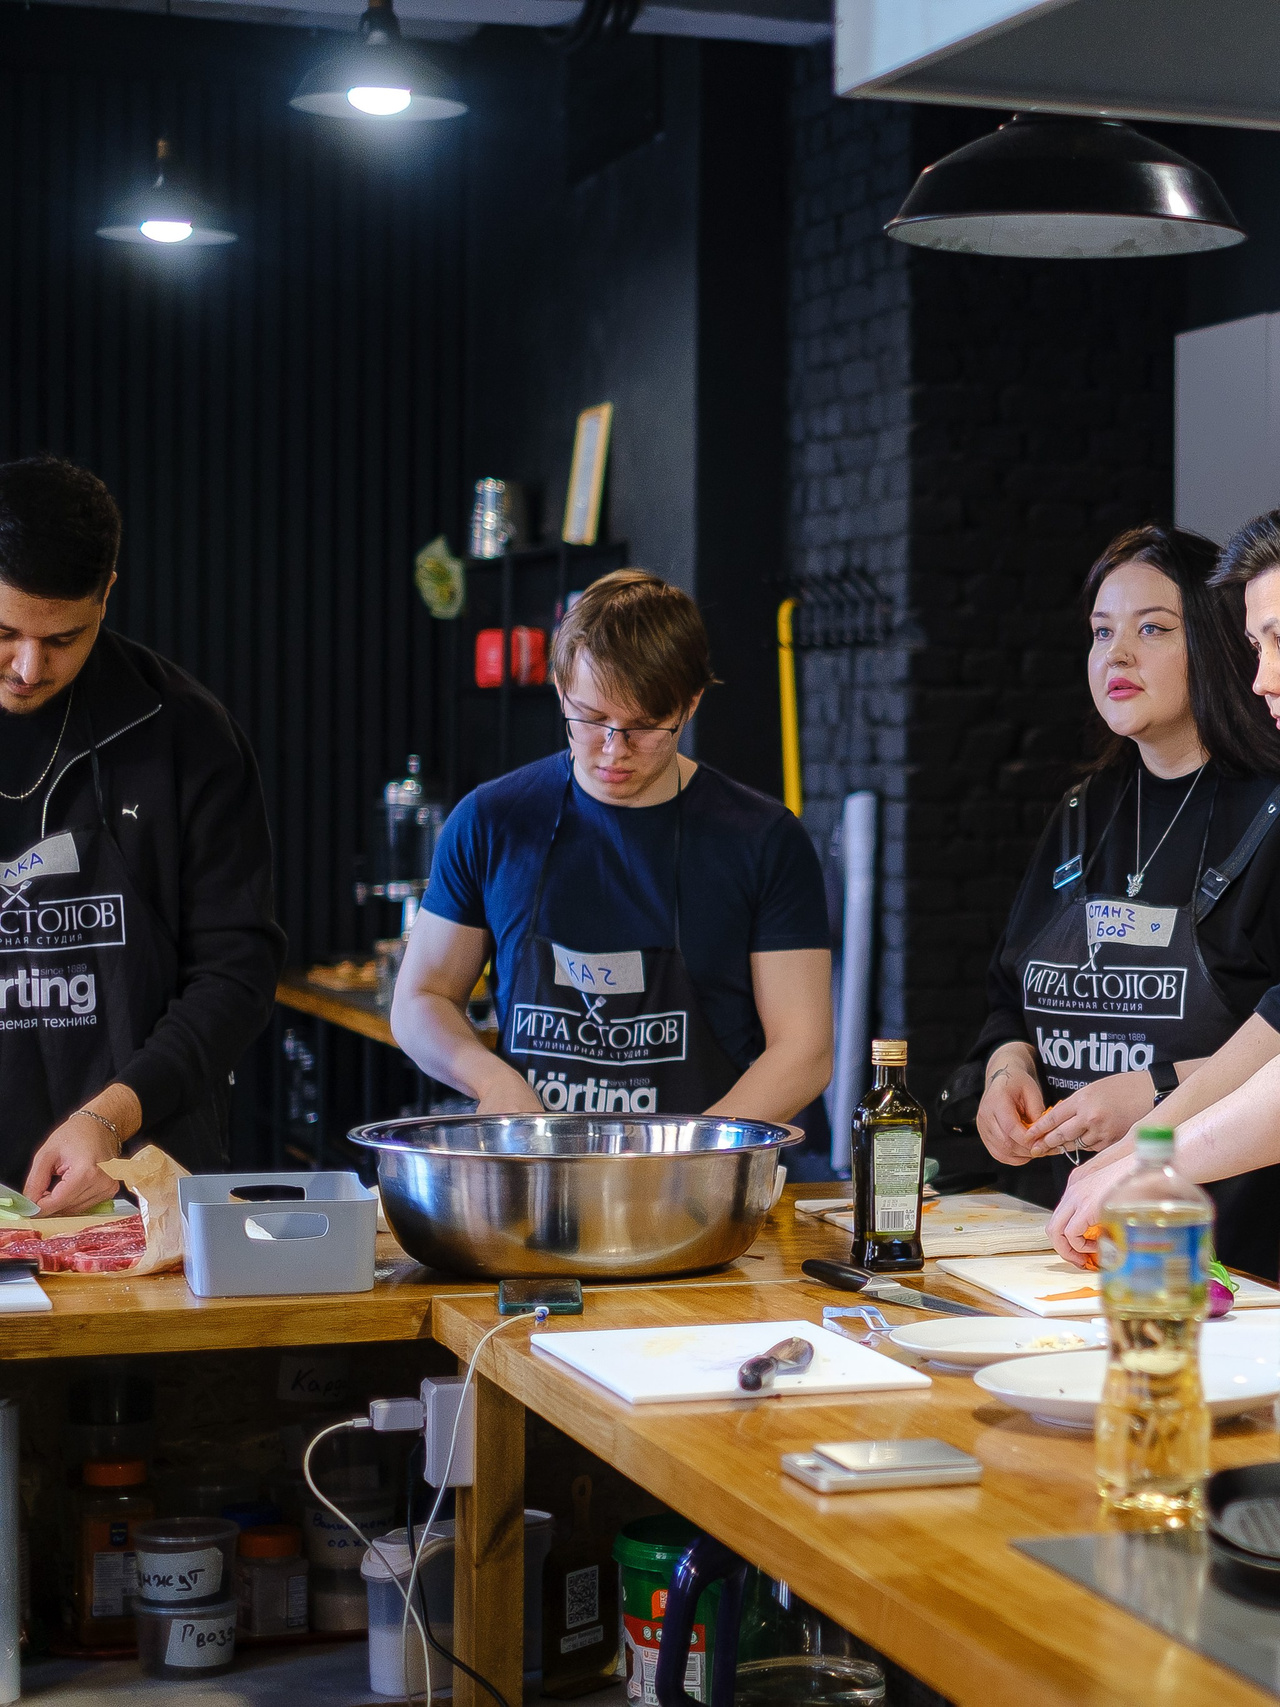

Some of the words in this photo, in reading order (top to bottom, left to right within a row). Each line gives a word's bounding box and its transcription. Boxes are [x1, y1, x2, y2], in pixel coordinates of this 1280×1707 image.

[0, 902, 116, 934] СТОЛОВ
[36, 933, 83, 945] СТУДИЯ
[1026, 968, 1069, 997] ИГРА
[1073, 973, 1177, 1000] СТОЛОВ
[1037, 997, 1098, 1010] КУЛИНАРНАЯ
[1102, 1000, 1144, 1012] СТУДИЯ
[42, 1014, 97, 1028] техника
[516, 1010, 570, 1041] ИГРА
[577, 1018, 679, 1050] СТОЛОВ
[533, 1040, 604, 1058] КУЛИНАРНАЯ
